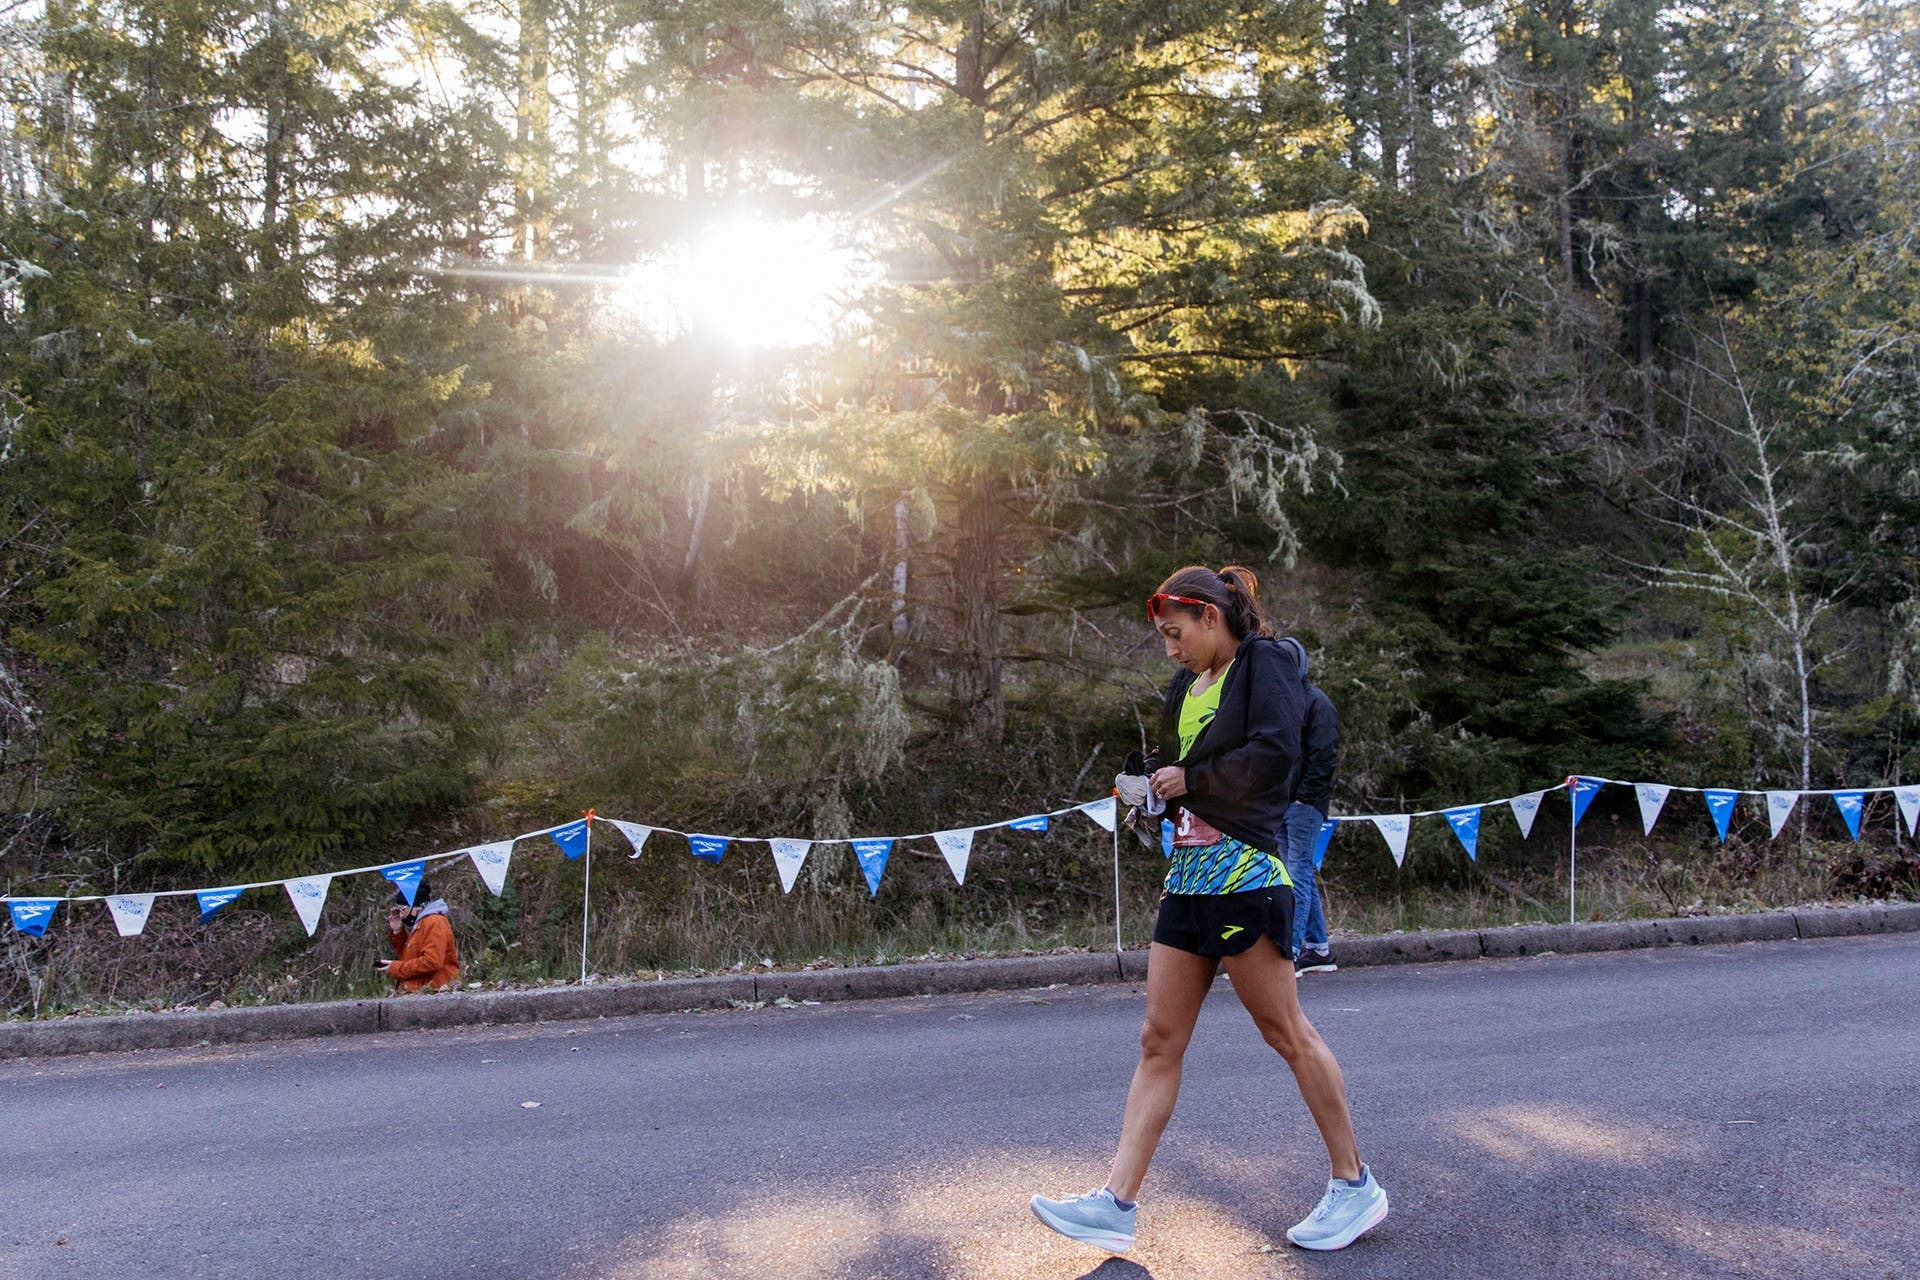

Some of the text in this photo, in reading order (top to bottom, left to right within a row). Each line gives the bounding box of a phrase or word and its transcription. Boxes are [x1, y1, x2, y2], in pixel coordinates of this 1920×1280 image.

[1177, 805, 1190, 837] 3
[387, 865, 421, 877] BROOKS
[201, 892, 238, 902] BROOKS
